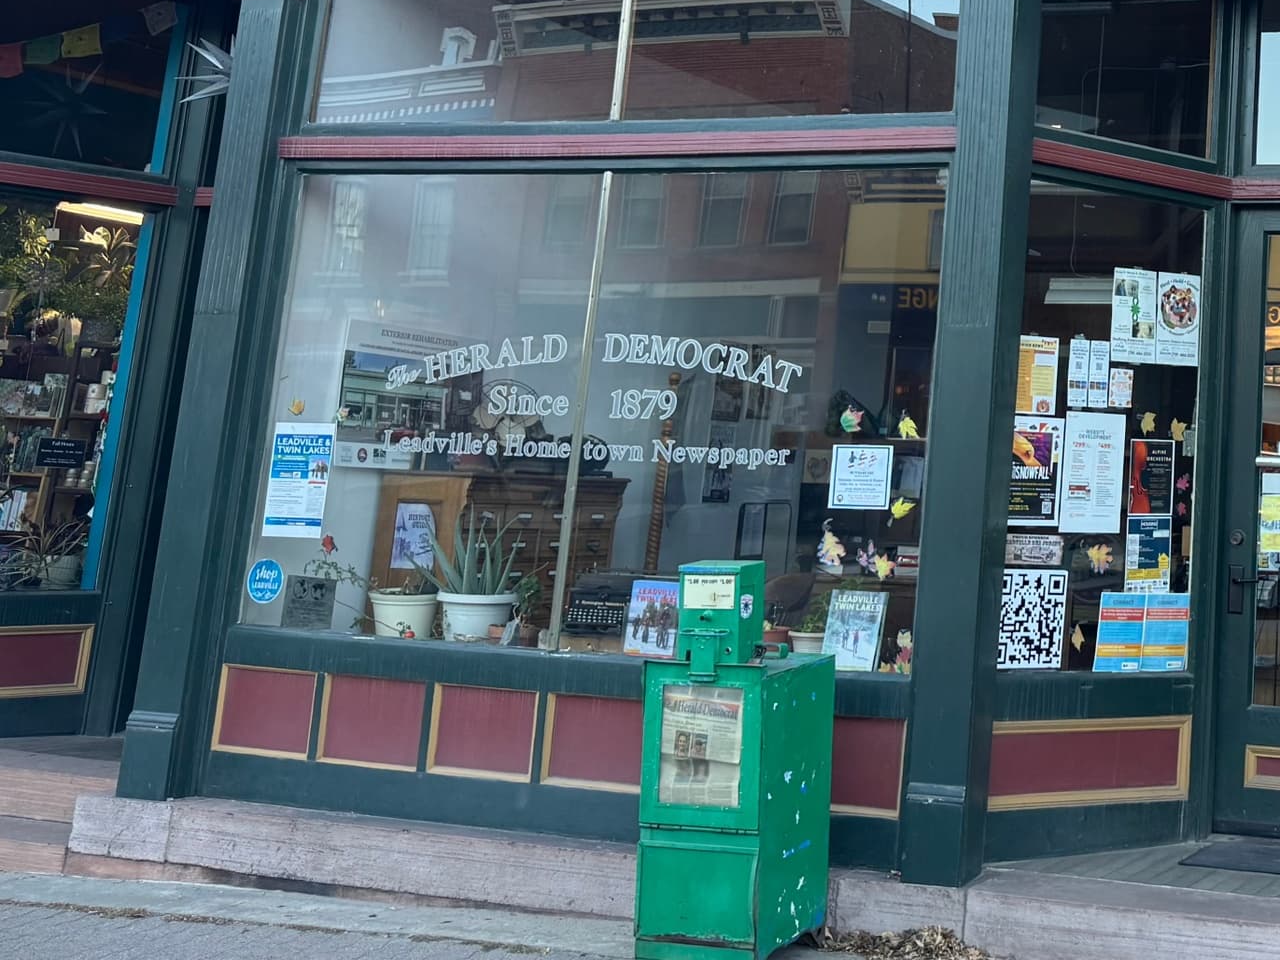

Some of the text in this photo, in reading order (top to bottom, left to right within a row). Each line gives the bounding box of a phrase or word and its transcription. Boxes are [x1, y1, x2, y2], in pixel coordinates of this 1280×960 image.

[385, 333, 803, 393] The HERALD DEMOCRAT
[487, 385, 678, 421] Since 1879
[277, 437, 331, 447] LEADVILLE &
[277, 445, 330, 455] TWIN LAKES
[382, 429, 791, 470] Leadville's Home town Newspaper
[255, 564, 278, 583] shop
[251, 580, 279, 590] LEADVILLE
[838, 593, 880, 604] LEADVILLE
[834, 601, 882, 613] TWIN LAKES
